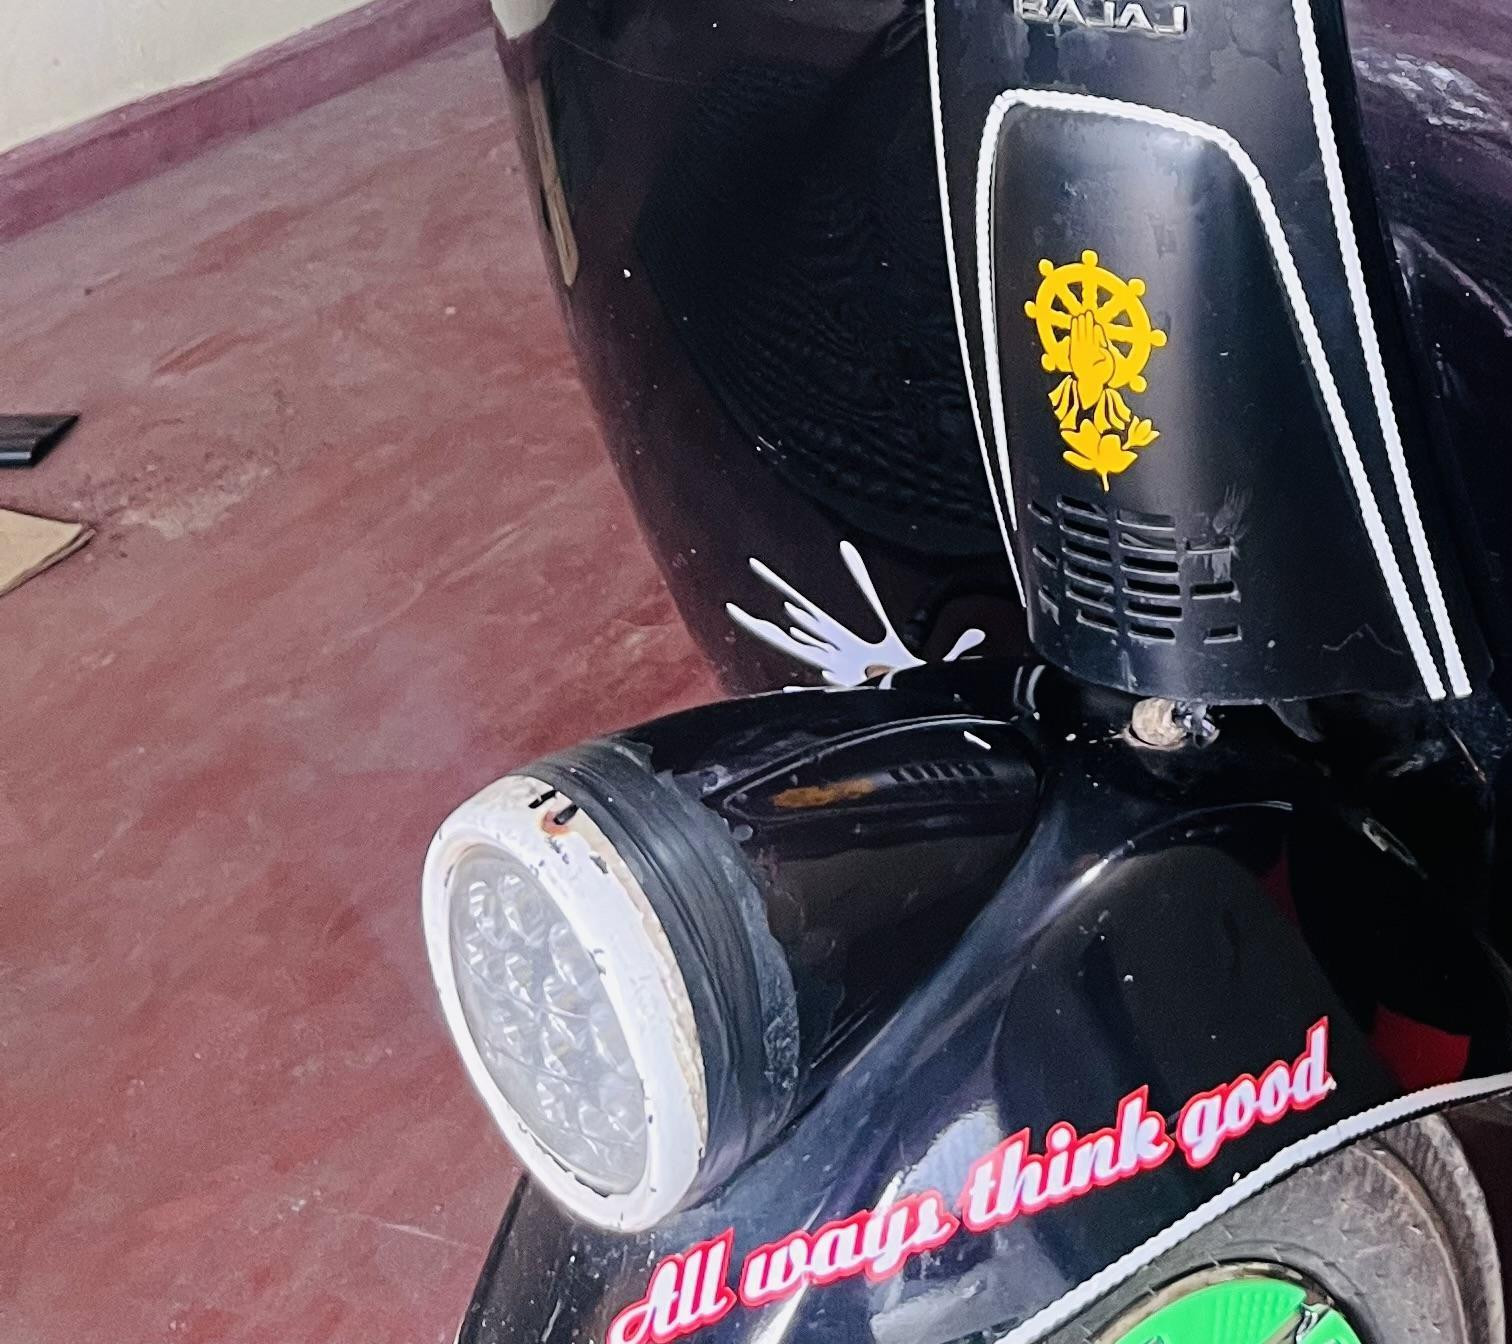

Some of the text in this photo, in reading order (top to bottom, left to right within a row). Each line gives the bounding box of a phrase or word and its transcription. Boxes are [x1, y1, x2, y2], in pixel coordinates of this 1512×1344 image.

[606, 1019, 1336, 1344] All ways think good
